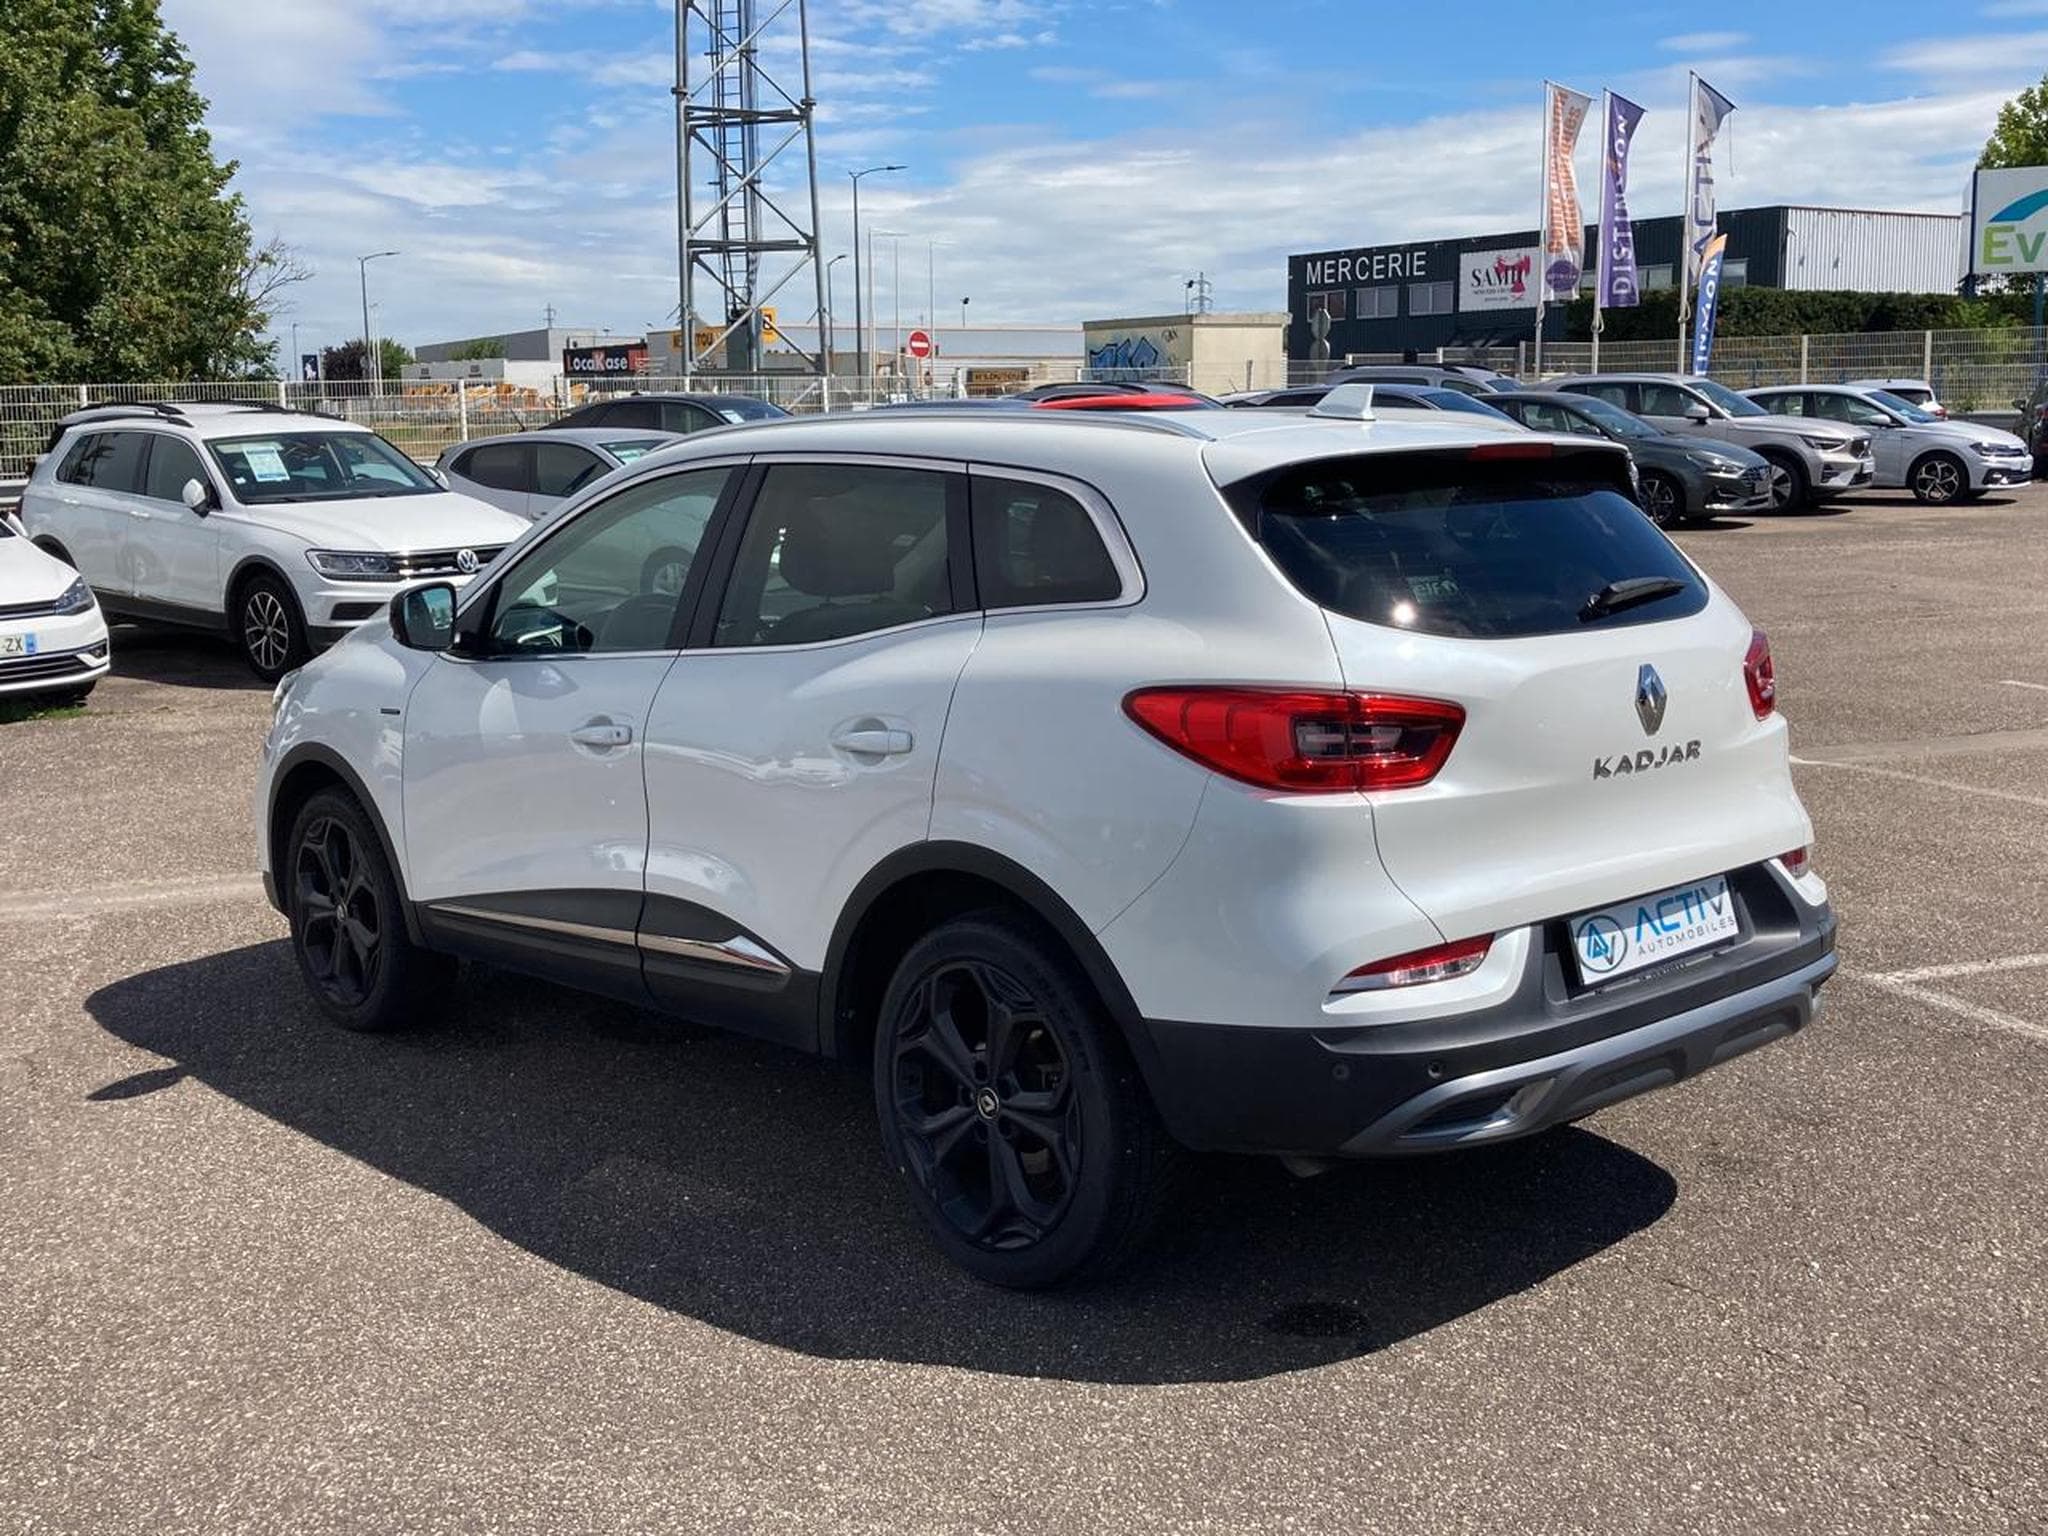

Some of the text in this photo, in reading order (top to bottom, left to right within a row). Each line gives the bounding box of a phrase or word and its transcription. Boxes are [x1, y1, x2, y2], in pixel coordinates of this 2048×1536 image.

[1611, 114, 1633, 296] DISTINON
[1305, 251, 1427, 285] MERCERIE
[1593, 739, 1702, 780] KADJAR
[1635, 880, 1725, 943] ACTIV
[1637, 915, 1736, 956] AUTOMOBILES
